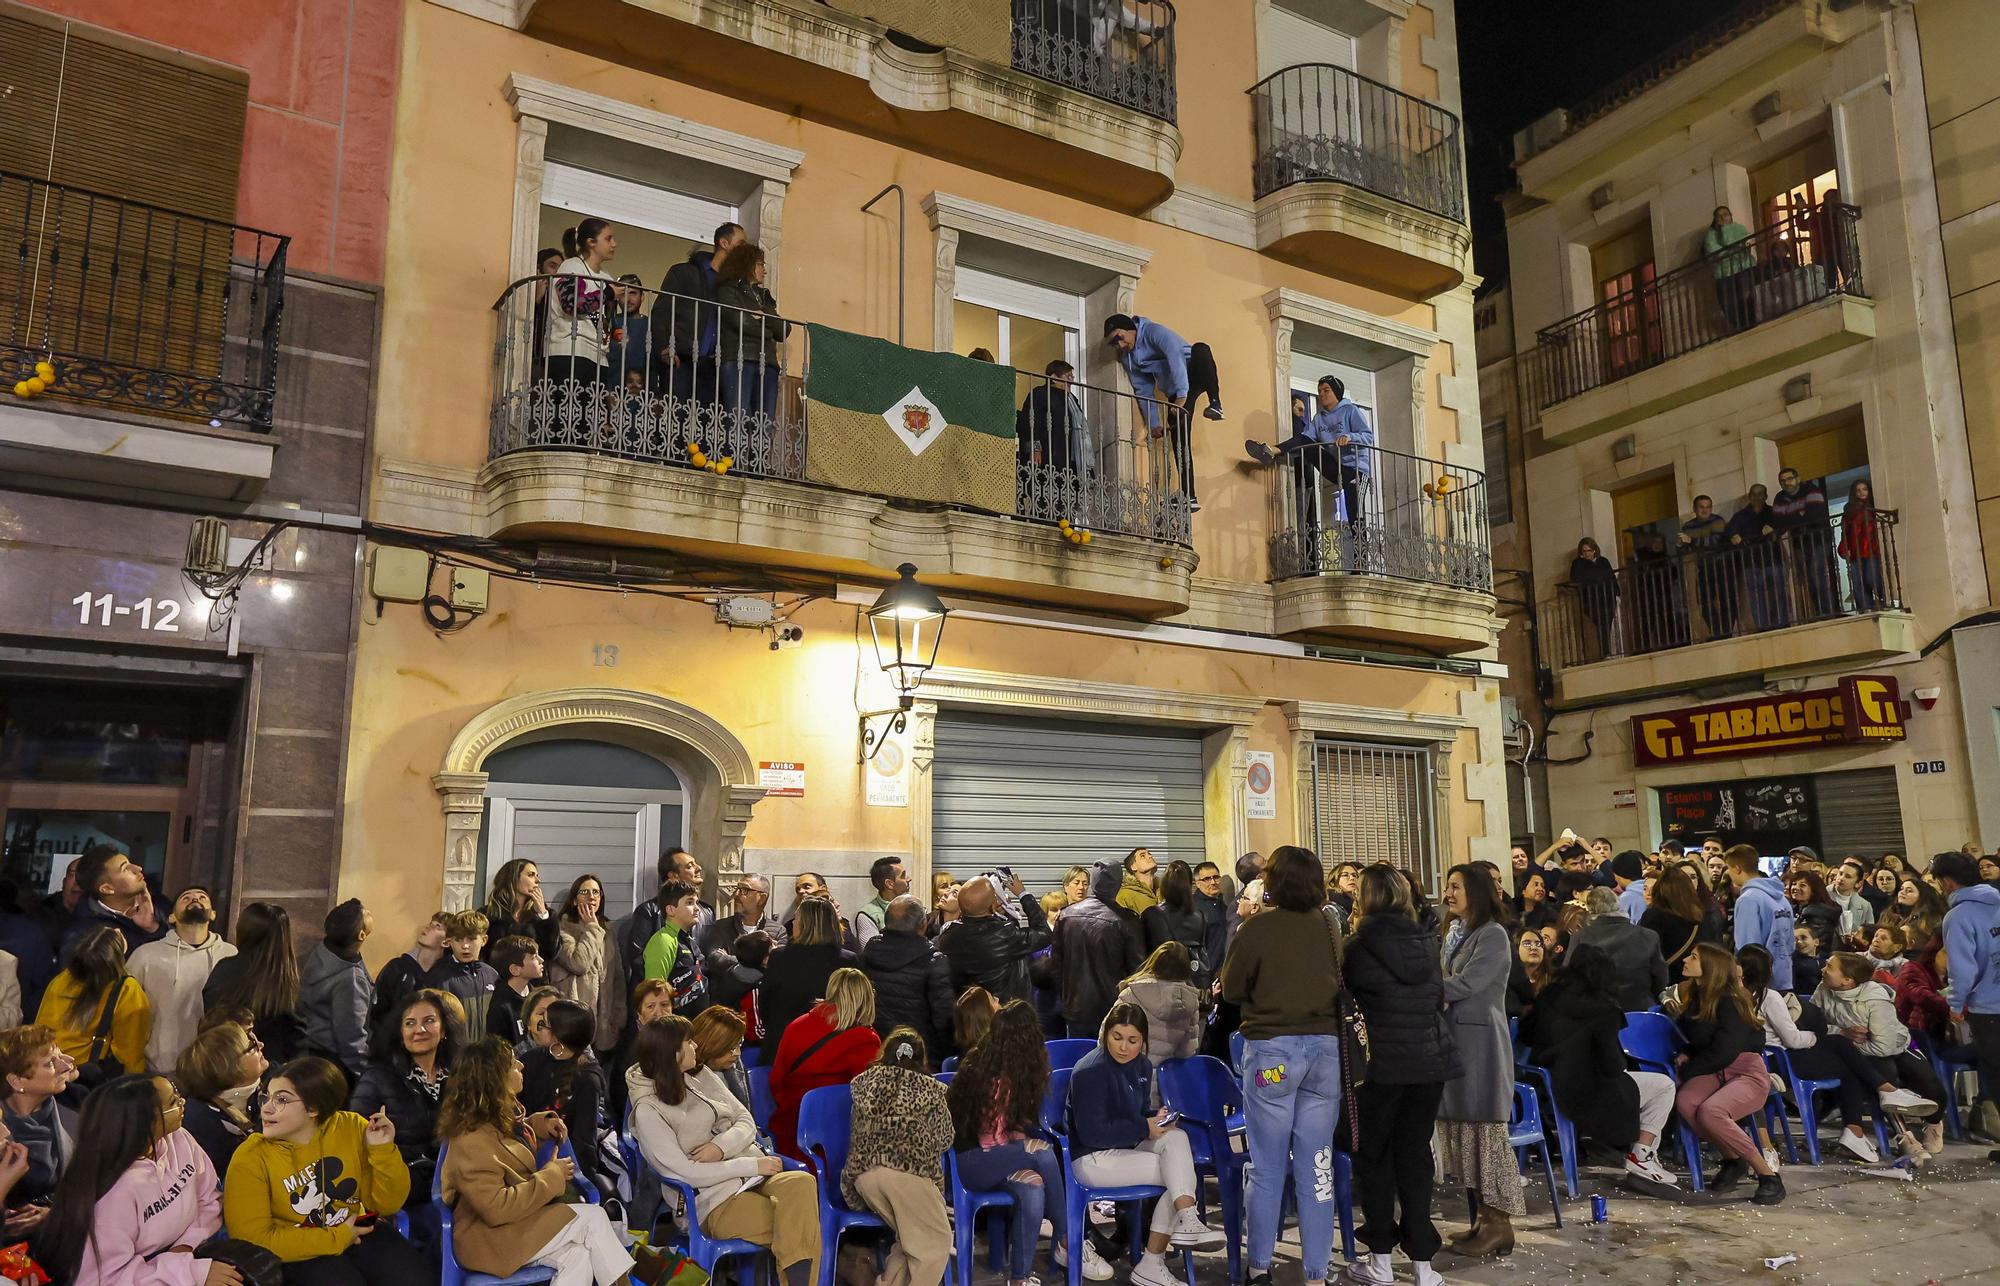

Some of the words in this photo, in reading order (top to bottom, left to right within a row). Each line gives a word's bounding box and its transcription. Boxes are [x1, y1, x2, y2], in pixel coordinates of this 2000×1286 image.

[73, 591, 181, 632] 11-12
[593, 644, 619, 667] 13
[1861, 726, 1904, 737] TABACOS
[770, 762, 795, 770] AVISO
[1915, 763, 1925, 773] 17
[869, 793, 906, 804] PERMANENTE
[1248, 809, 1275, 817] PERMANENTE
[1312, 1145, 1334, 1203] NYC
